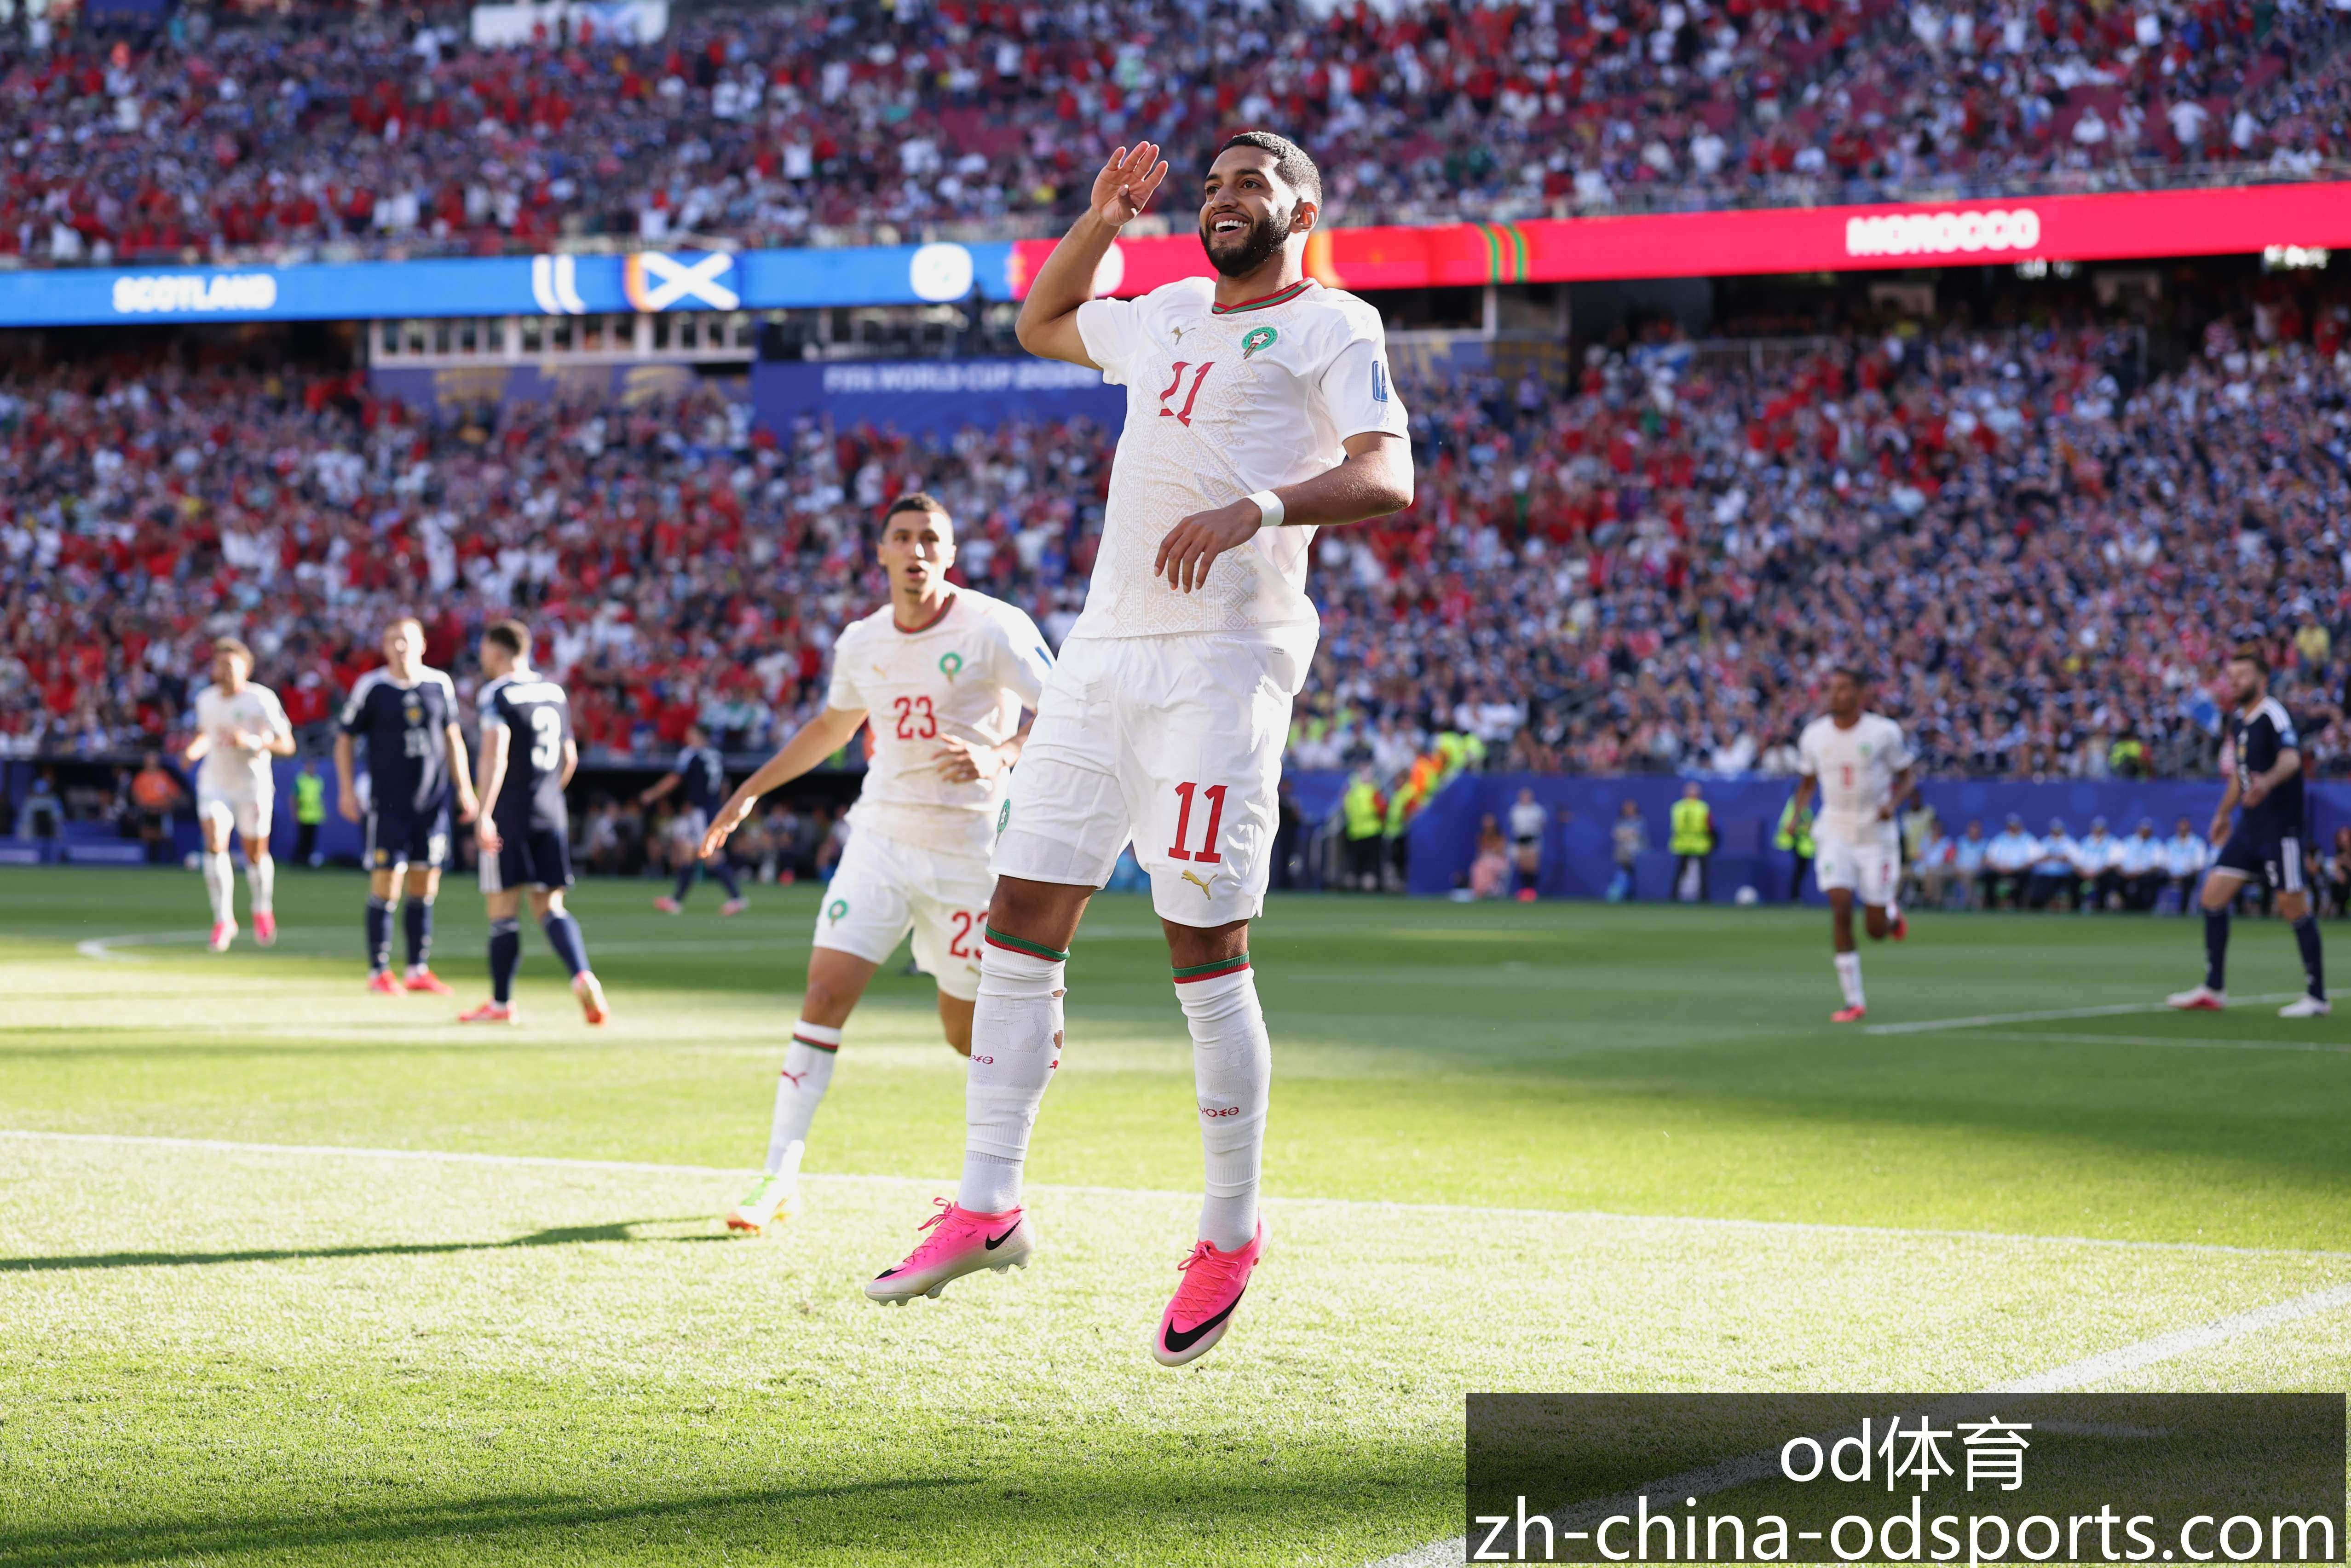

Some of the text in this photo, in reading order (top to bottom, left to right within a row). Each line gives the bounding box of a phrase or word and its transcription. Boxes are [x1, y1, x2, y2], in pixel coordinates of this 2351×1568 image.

[1846, 209, 2040, 256] MOROCCO
[114, 274, 276, 312] SCOTLAND
[531, 706, 561, 771] 3
[894, 695, 937, 740] 23
[1168, 781, 1228, 863] 11
